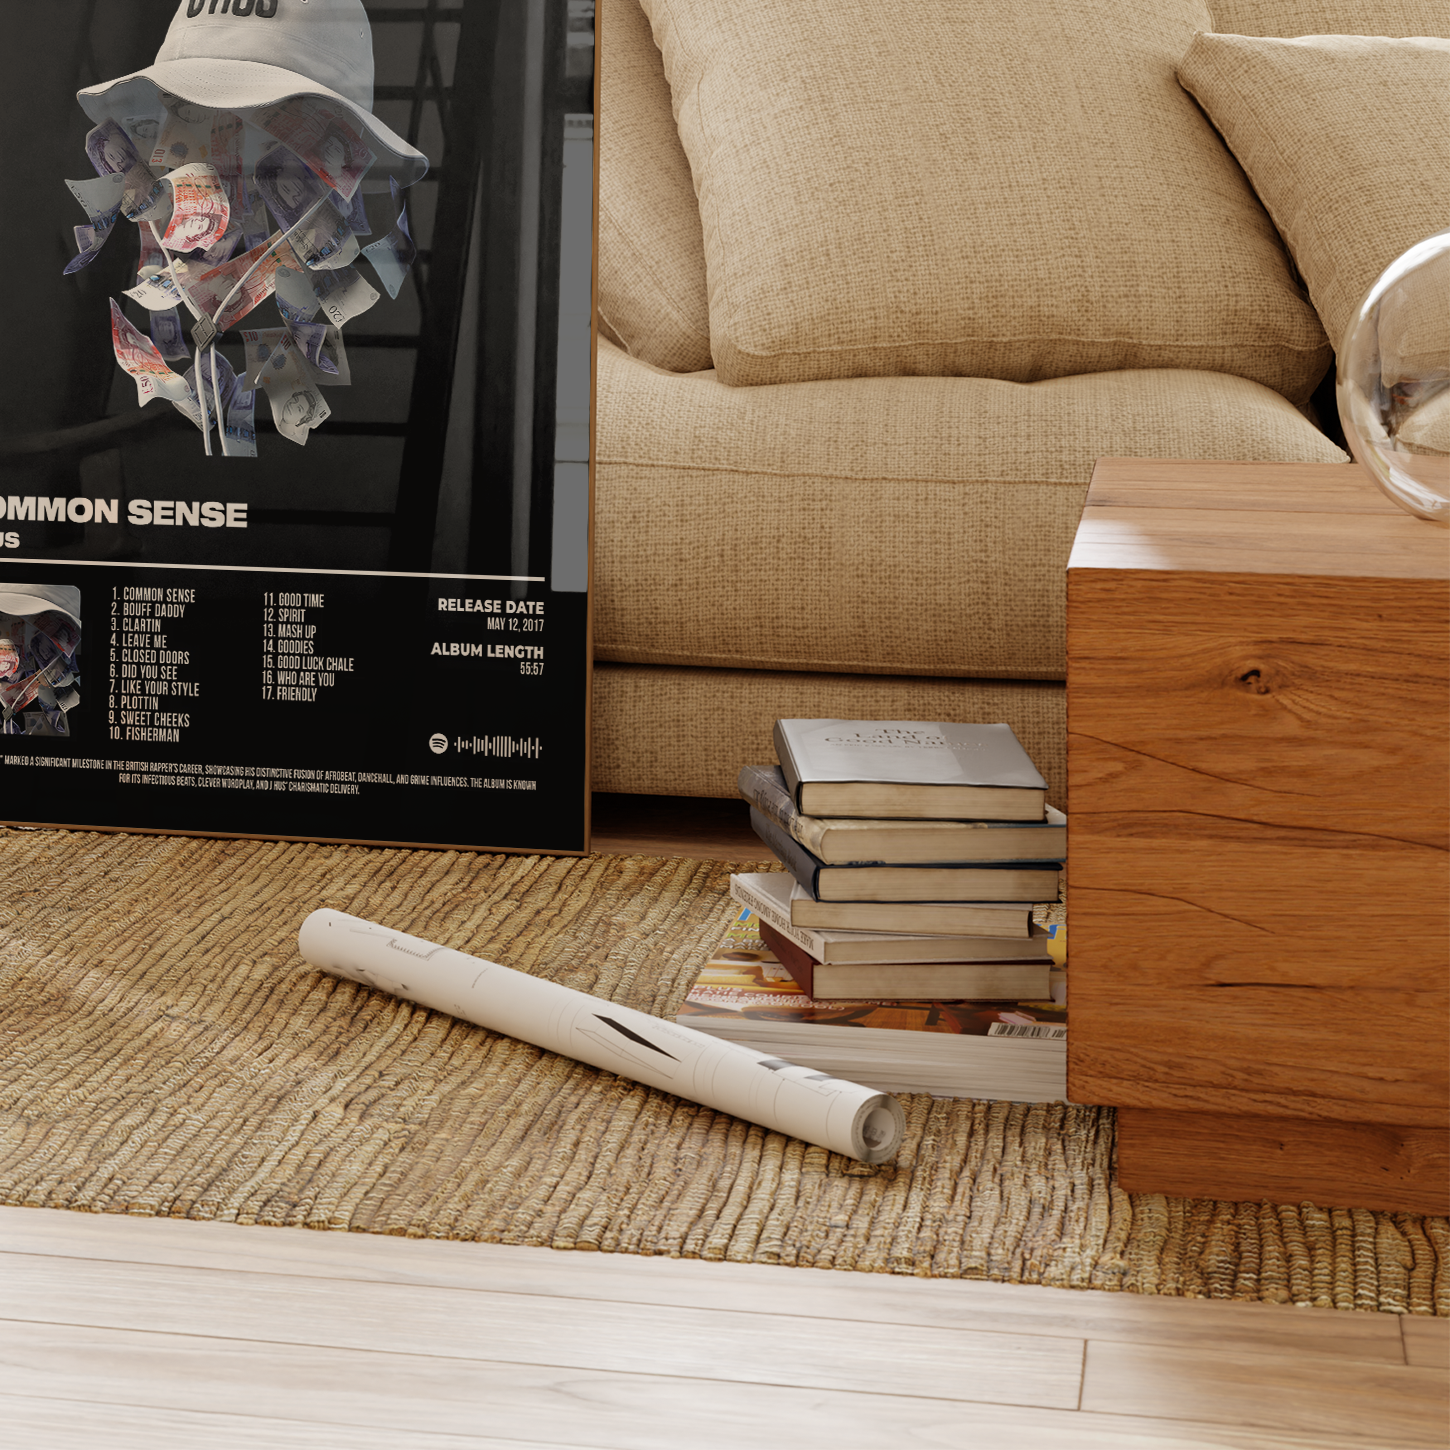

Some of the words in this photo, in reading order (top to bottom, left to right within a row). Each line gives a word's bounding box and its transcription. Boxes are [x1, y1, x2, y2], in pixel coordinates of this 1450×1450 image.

[127, 499, 248, 528] SENSE
[113, 586, 120, 600] 1.
[123, 586, 165, 602] COMMON
[166, 588, 195, 603] SENSE
[264, 592, 276, 606] 11.
[279, 592, 303, 607] GOOD
[303, 593, 324, 608] TIME
[111, 601, 120, 615] 2.
[123, 602, 152, 616] BOUFF
[154, 603, 185, 619] DADDY
[438, 598, 501, 613] RELEASE
[506, 600, 544, 614] DATE
[264, 607, 276, 622] 12.
[278, 608, 306, 623] SPIRIT
[111, 617, 119, 631] 3.
[123, 617, 161, 632] CLARTIN
[263, 623, 276, 637] 13.
[278, 624, 303, 638] MASH
[305, 625, 316, 639] UP
[487, 617, 506, 630] MAY
[508, 618, 520, 632] 12,
[523, 618, 544, 632] 2017
[110, 632, 119, 646] 4.
[122, 633, 151, 648] LEAVE
[154, 635, 168, 649] ME
[263, 639, 275, 653] 14.
[278, 639, 314, 654] GOODIES
[110, 648, 119, 662] 5.
[122, 648, 156, 664] CLOSED
[159, 650, 190, 665] DOORS
[430, 642, 482, 657] ALBUM
[487, 644, 544, 659] LENGTH
[263, 654, 275, 668] 15.
[277, 655, 300, 669] GOOD
[302, 656, 324, 670] LUCK
[326, 657, 354, 672] CHALE
[520, 662, 544, 675] 55:57
[110, 663, 118, 677] 6.
[122, 664, 137, 678] DID
[140, 665, 158, 679] YOU
[160, 666, 177, 680] SEE
[262, 670, 275, 684] 16.
[277, 671, 297, 685] WHO
[299, 671, 316, 686] ARE
[318, 672, 335, 687] YOU
[109, 679, 118, 693] 7.
[121, 680, 141, 694] LIKE
[144, 680, 168, 695] YOUR
[171, 682, 200, 697] STYLE
[262, 686, 274, 700] 17.
[277, 686, 317, 702] FRIENDLY
[109, 694, 118, 708] 8.
[121, 695, 158, 710] PLOTTIN
[108, 710, 117, 724] 9.
[120, 710, 151, 725] SWEET
[154, 712, 190, 727] CHEEKS
[109, 726, 123, 740] 10.
[126, 726, 179, 742] FISHERMAN
